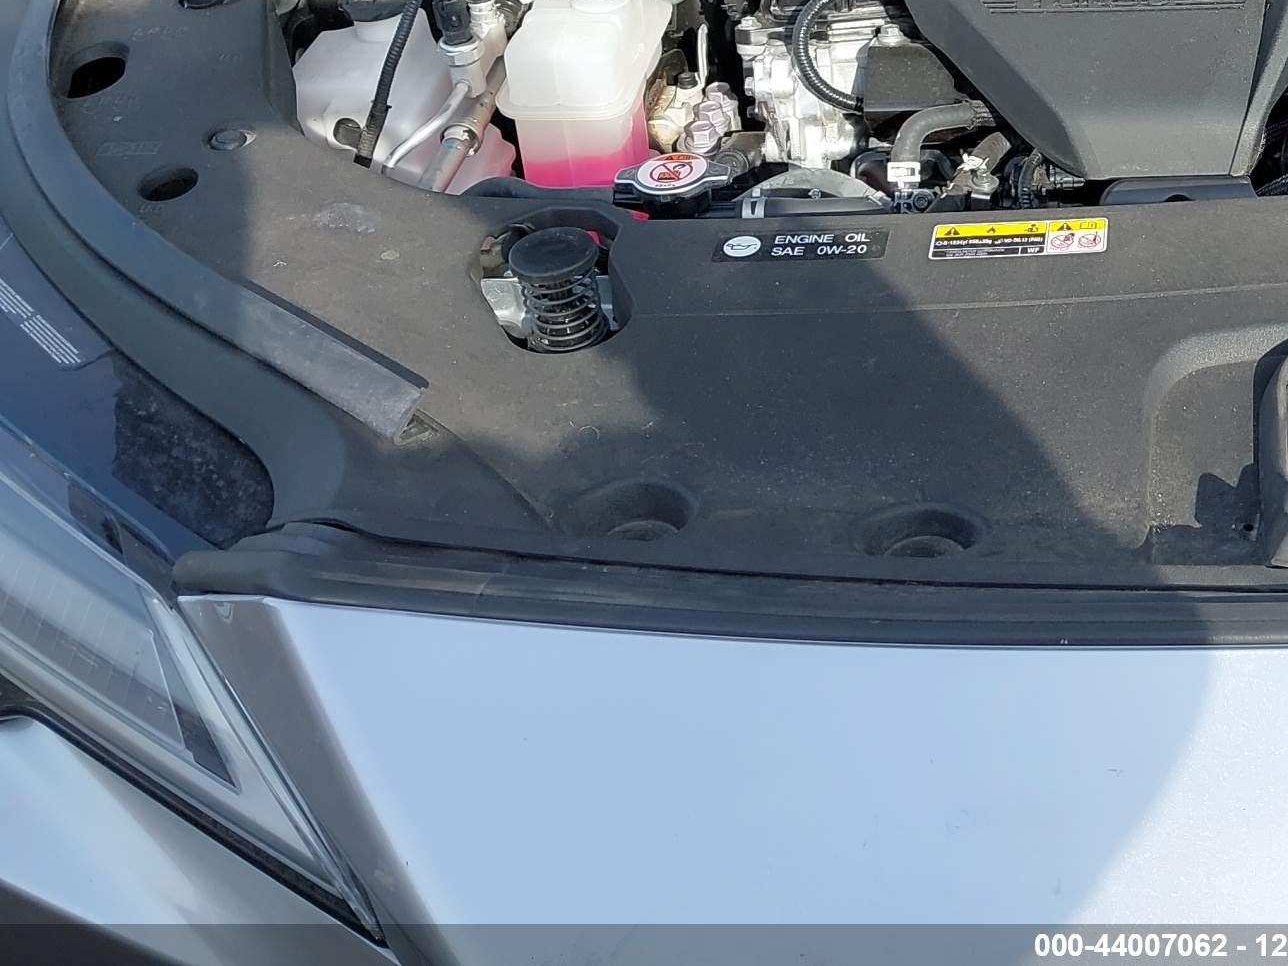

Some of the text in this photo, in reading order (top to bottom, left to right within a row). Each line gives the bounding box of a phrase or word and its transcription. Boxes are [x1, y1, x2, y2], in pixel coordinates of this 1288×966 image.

[774, 232, 871, 245] ENGINE OIL
[770, 244, 868, 256] SAE 0W-20
